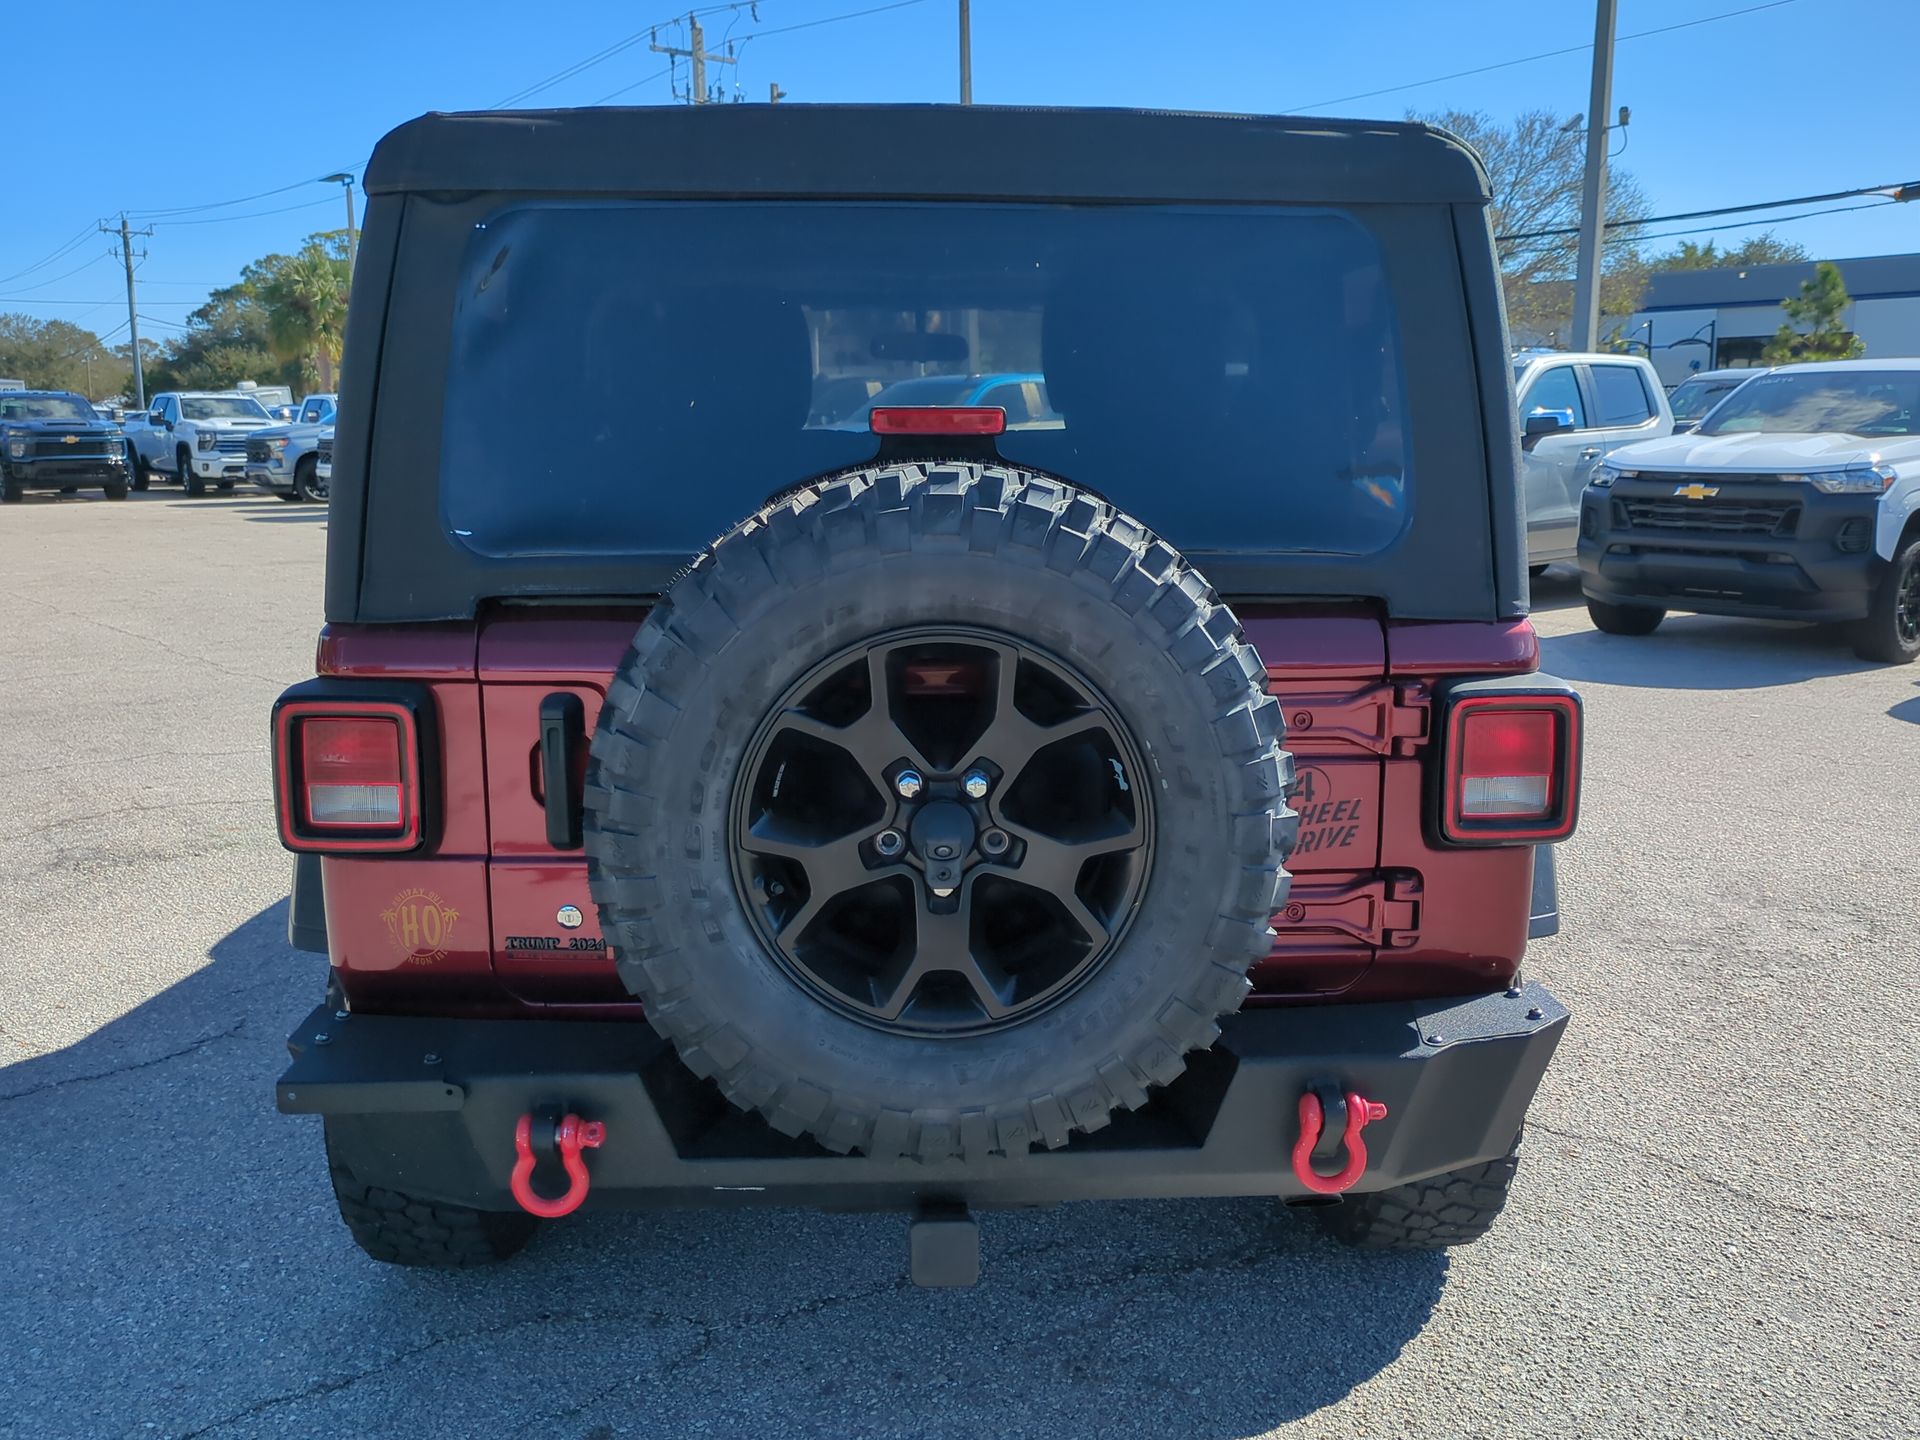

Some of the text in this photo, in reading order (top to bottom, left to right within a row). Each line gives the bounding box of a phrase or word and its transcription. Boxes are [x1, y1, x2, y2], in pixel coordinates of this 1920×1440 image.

[1285, 771, 1314, 802] 4
[1295, 799, 1362, 827] HEEL
[1289, 825, 1360, 855] RIVE
[401, 904, 442, 947] HO
[506, 936, 606, 951] TRUMP 2024
